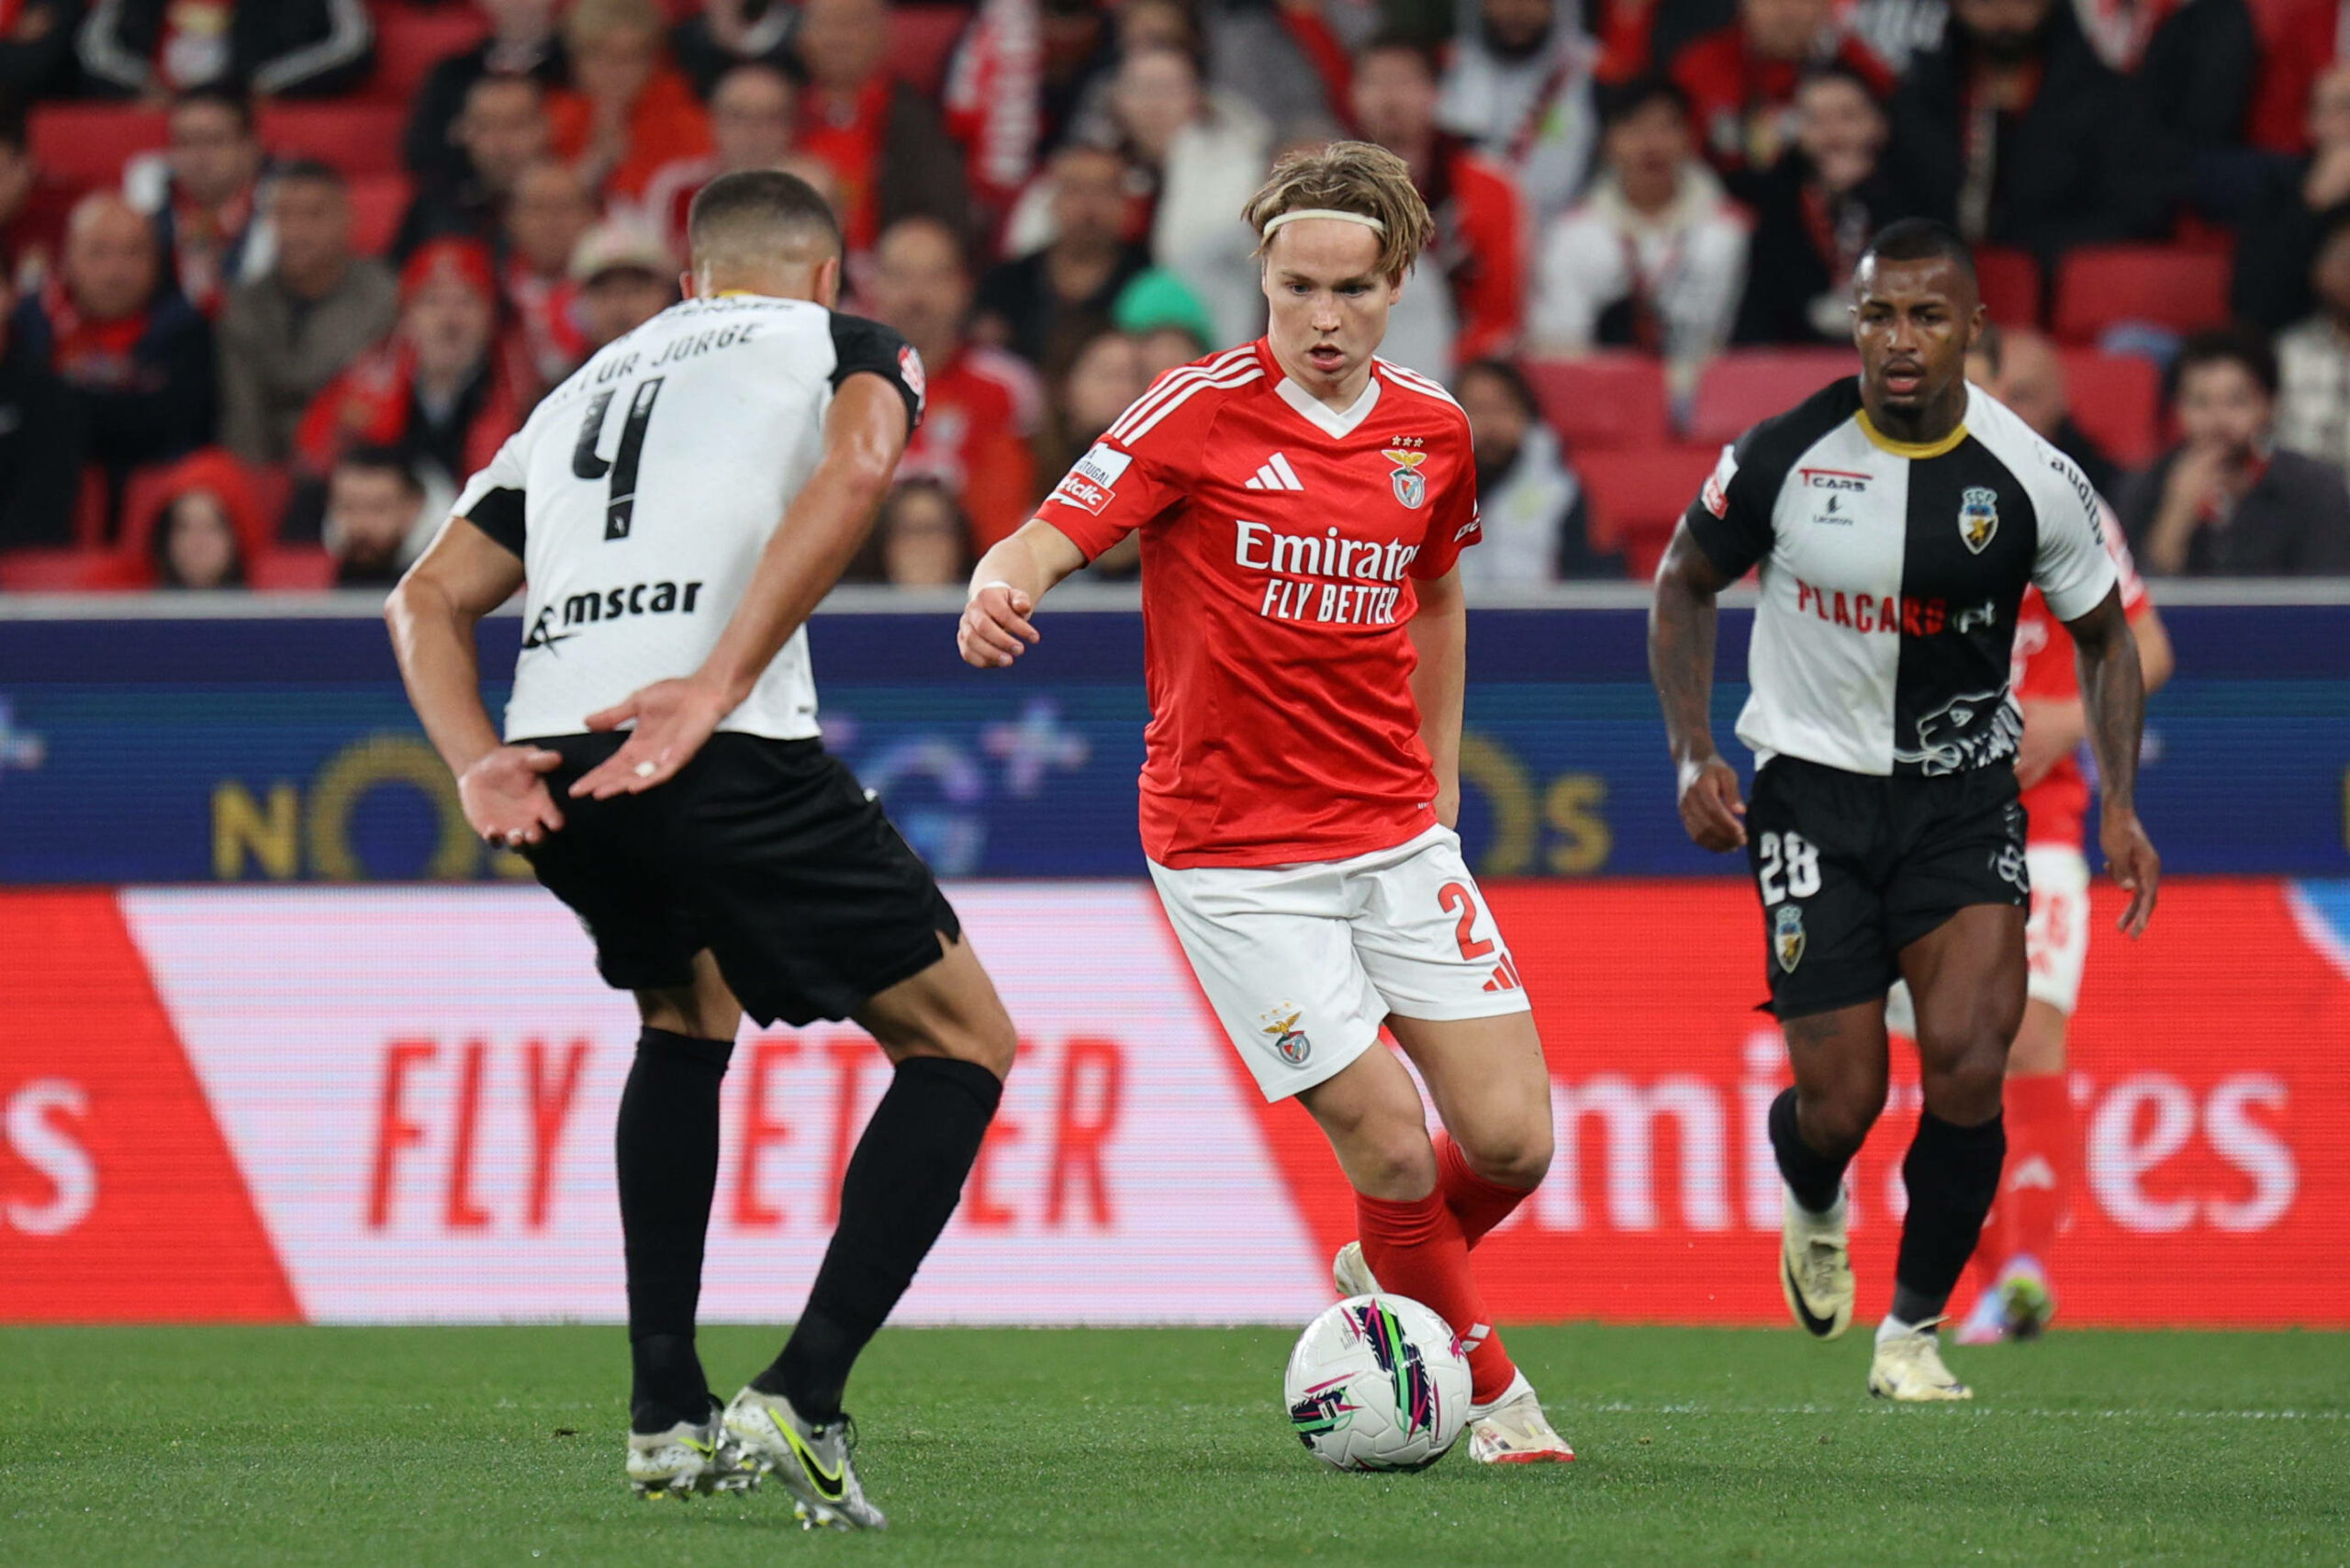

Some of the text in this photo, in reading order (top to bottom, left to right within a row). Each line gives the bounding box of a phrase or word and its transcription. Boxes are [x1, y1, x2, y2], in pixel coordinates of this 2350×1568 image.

[652, 322, 764, 367] JORGE
[571, 376, 666, 542] 4
[1260, 578, 1400, 625] FLY BETTER
[210, 733, 535, 879] NO
[1759, 830, 1821, 907] 28
[1438, 881, 1495, 961] 2
[367, 1037, 1125, 1230] FLY ETER
